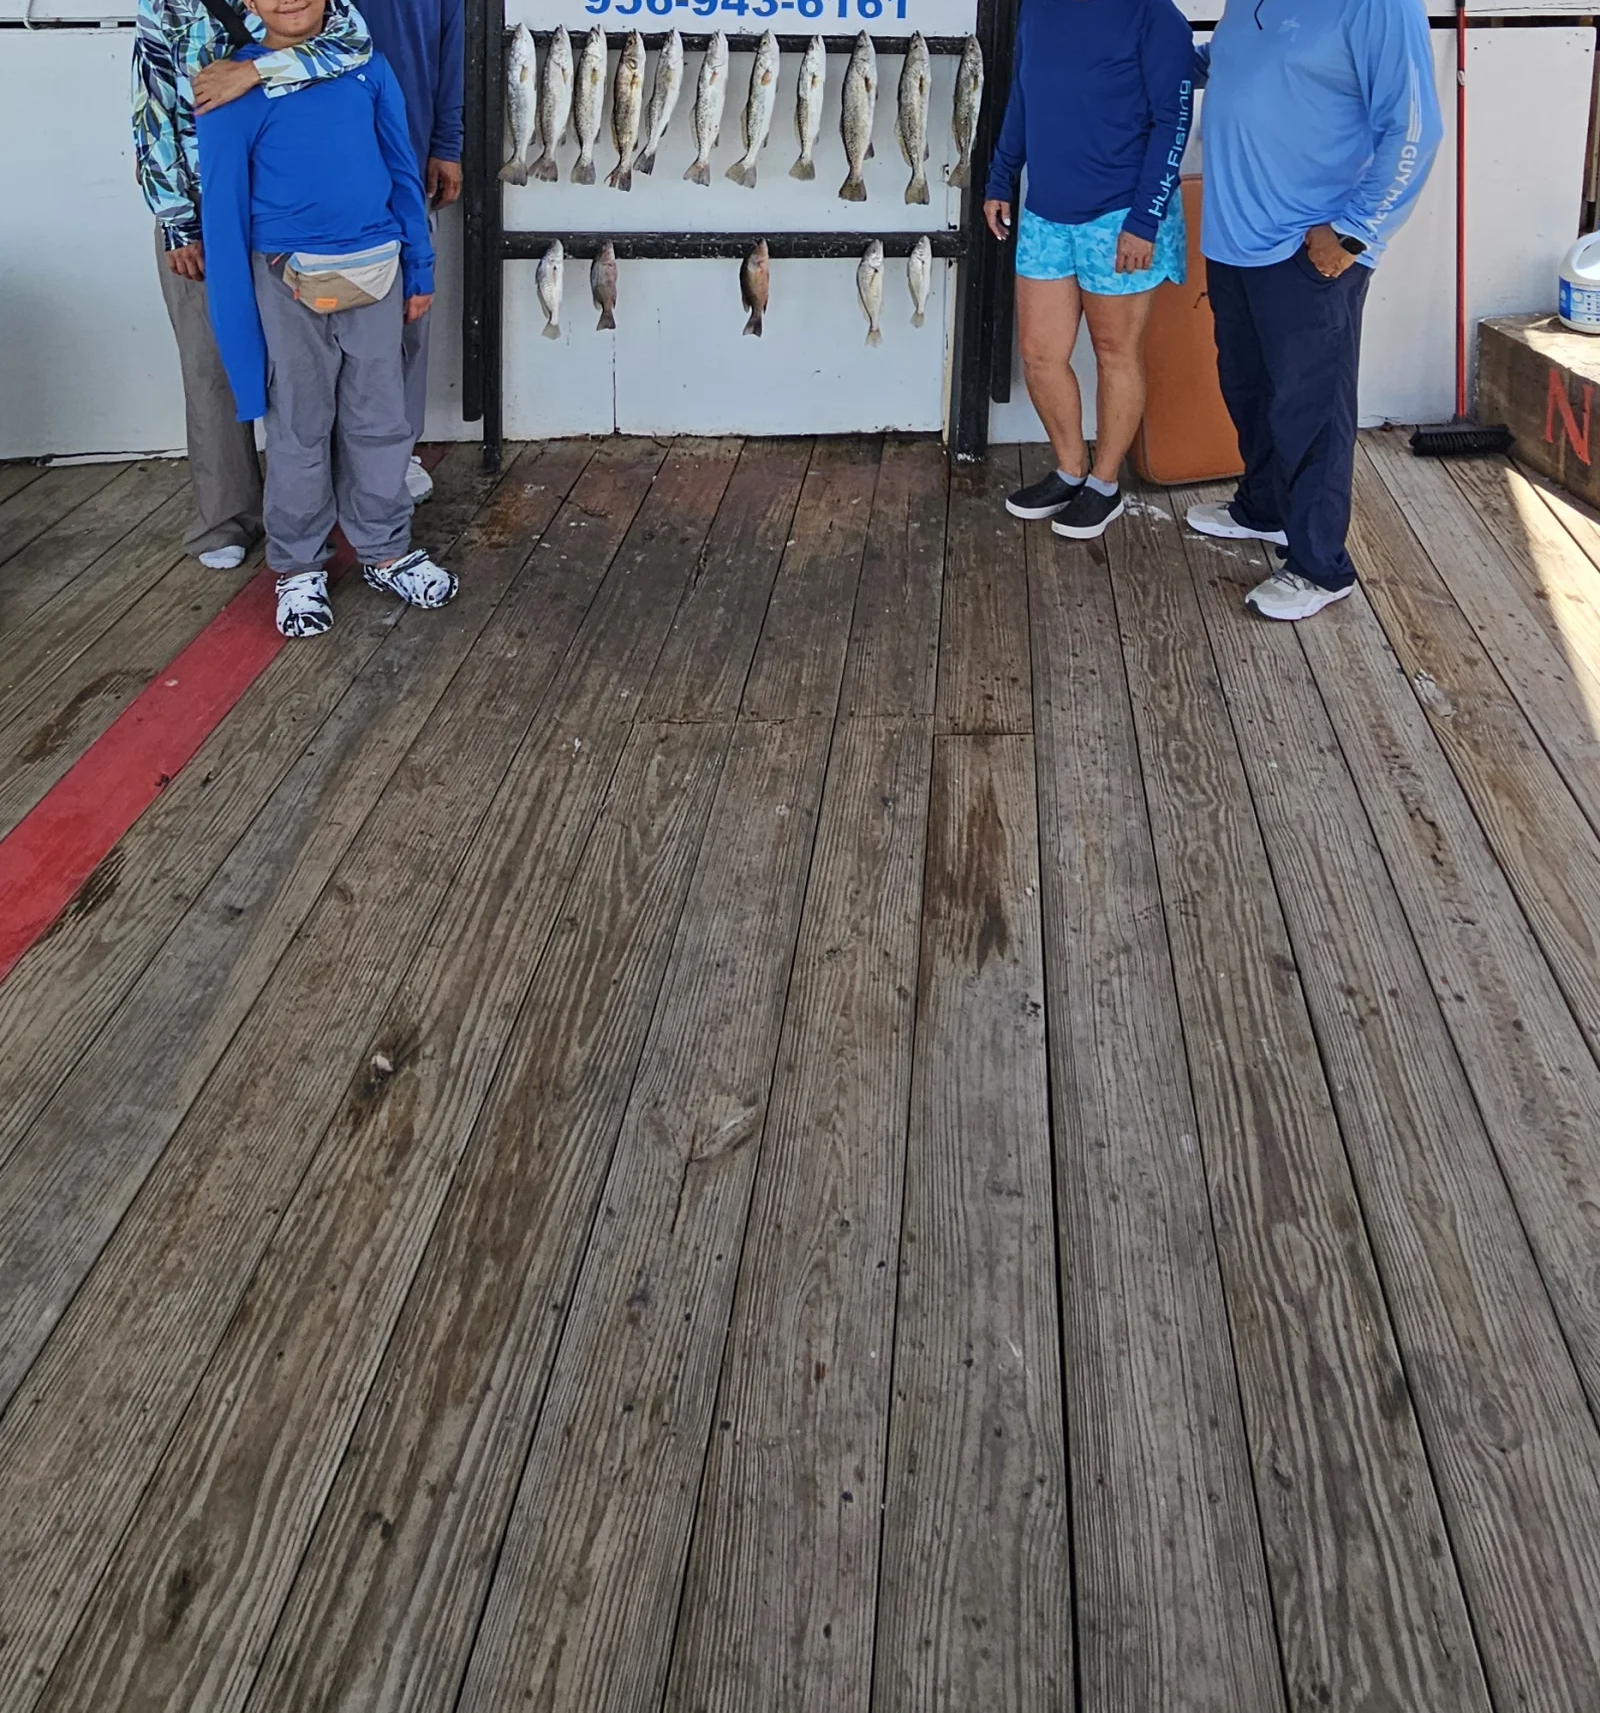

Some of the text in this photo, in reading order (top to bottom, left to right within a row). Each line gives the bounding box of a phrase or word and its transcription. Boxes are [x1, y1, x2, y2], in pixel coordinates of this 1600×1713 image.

[1148, 80, 1191, 217] Huk Fishing
[1395, 145, 1417, 186] GUY
[1545, 368, 1592, 465] N
